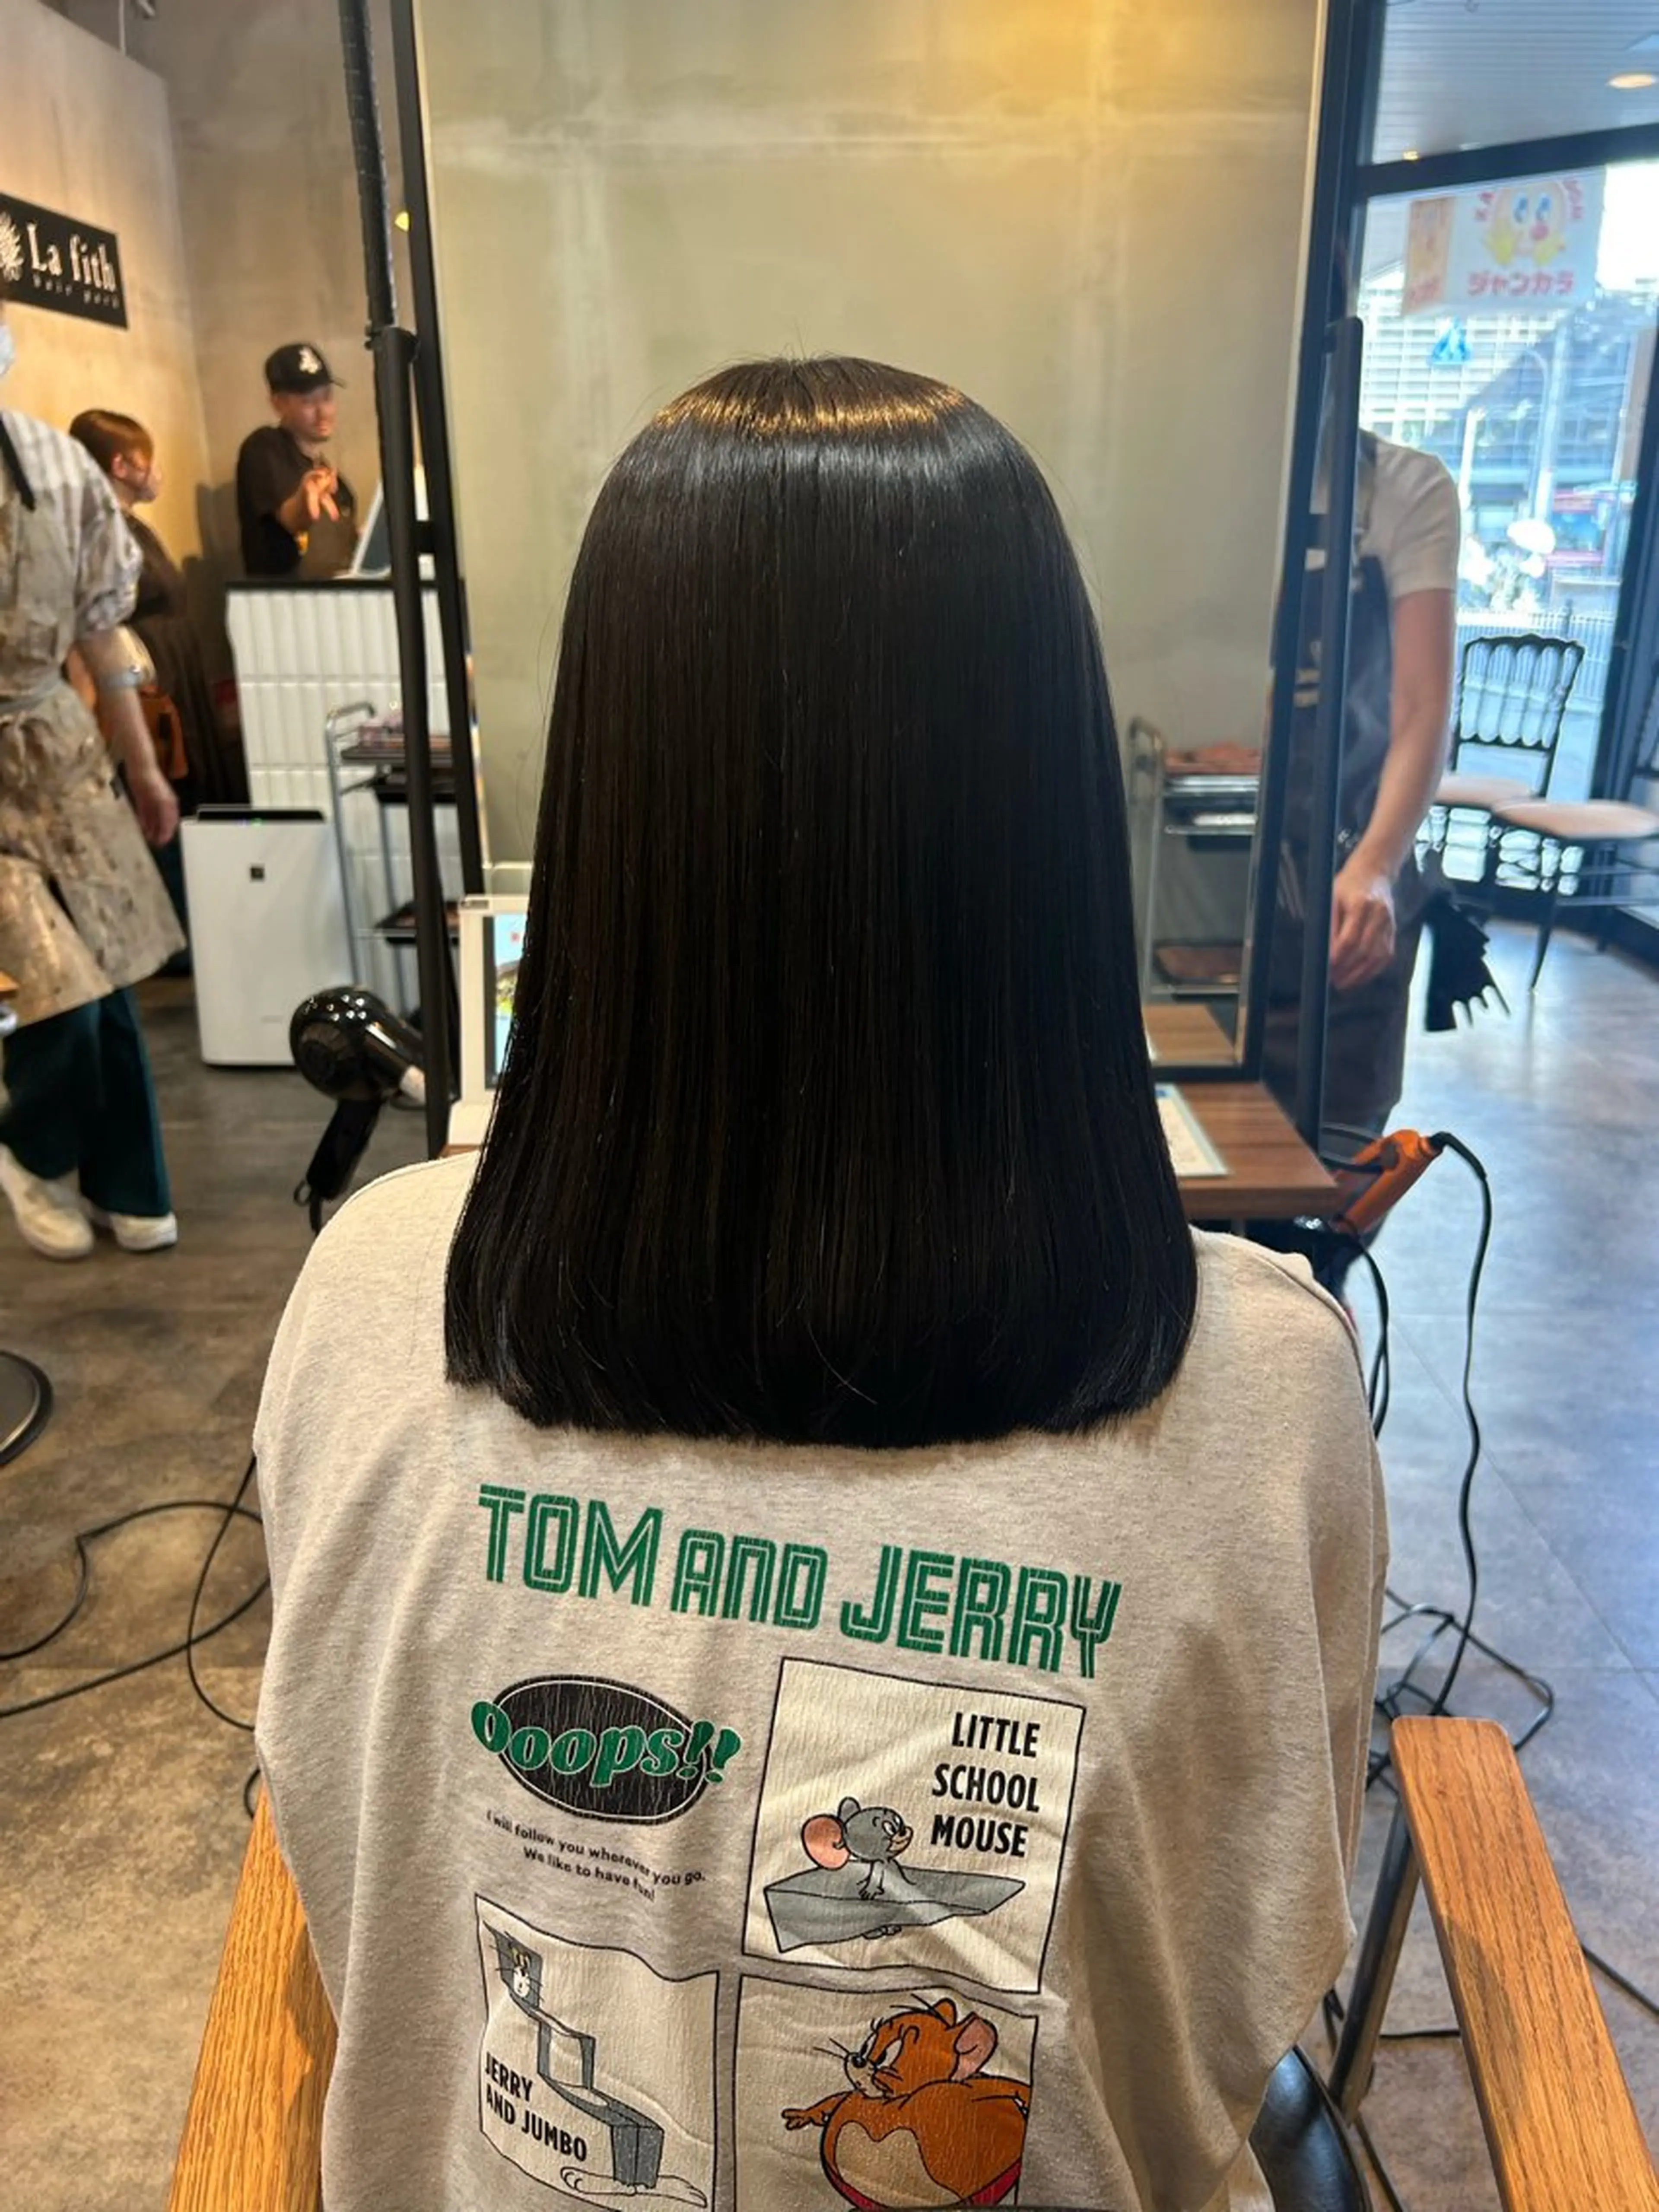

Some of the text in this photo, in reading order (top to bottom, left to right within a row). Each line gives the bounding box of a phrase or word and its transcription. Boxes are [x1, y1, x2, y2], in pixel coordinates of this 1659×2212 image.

[27, 221, 63, 276] La
[479, 1484, 1122, 1679] TOM AND JERRY
[952, 1712, 1040, 1758] LITTLE
[932, 1763, 1040, 1813] SCHOOL
[493, 1815, 513, 1833] will
[515, 1824, 554, 1845] follow
[559, 1840, 584, 1855] you
[588, 1847, 650, 1876] wherever
[653, 1871, 681, 1885] you
[685, 1871, 706, 1886] go.
[930, 1814, 1029, 1858] MOUSE
[523, 1846, 544, 1863] We
[547, 1853, 572, 1872] like
[576, 1864, 591, 1878] to
[595, 1866, 630, 1886] have
[485, 2051, 533, 2101] JERRY
[486, 2082, 588, 2161] AND JUMBO
